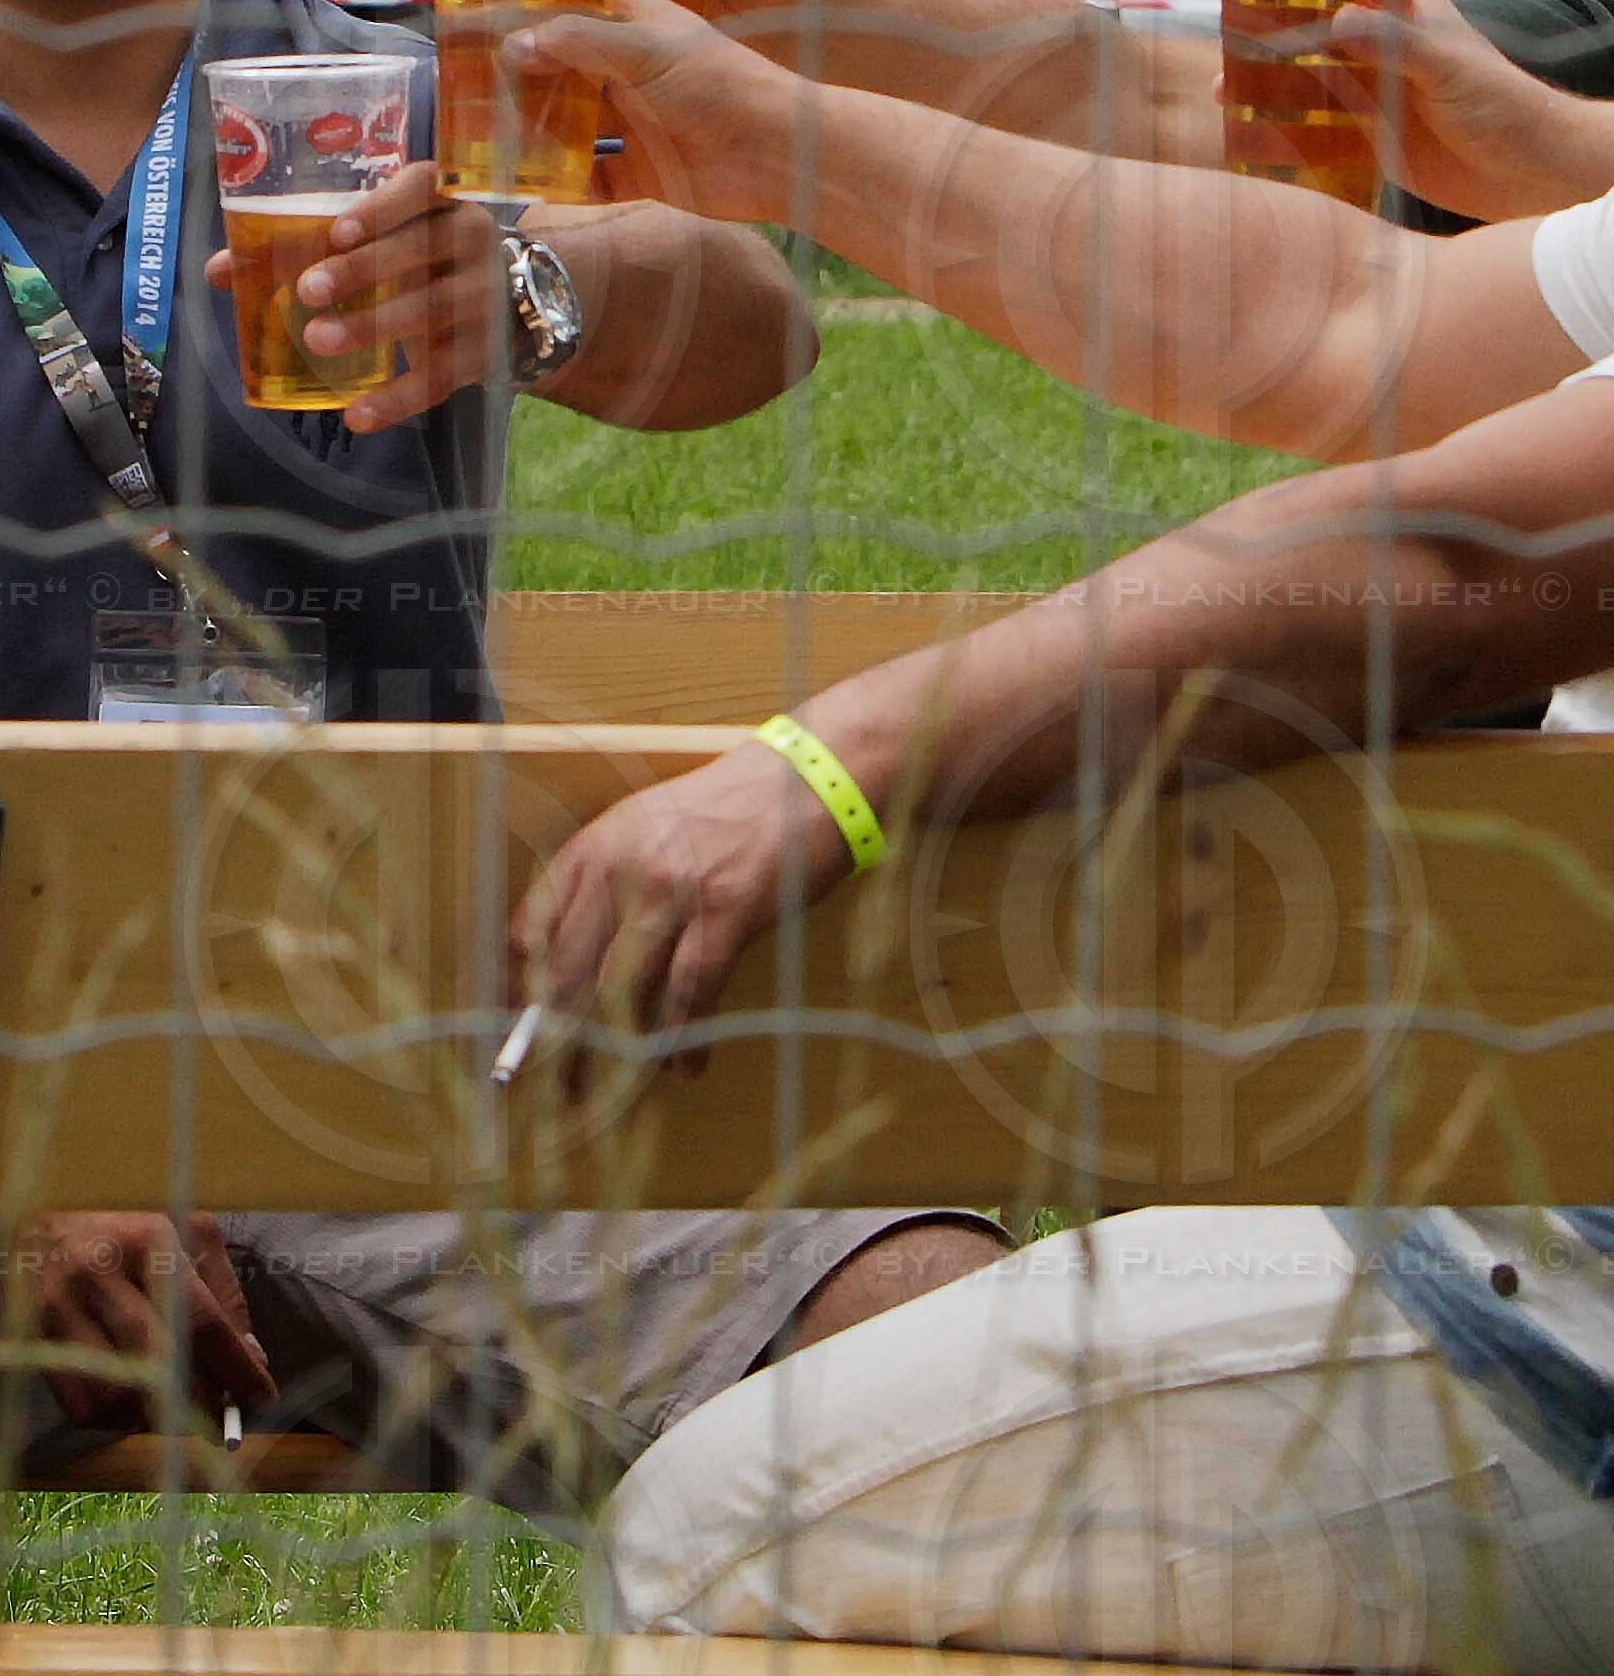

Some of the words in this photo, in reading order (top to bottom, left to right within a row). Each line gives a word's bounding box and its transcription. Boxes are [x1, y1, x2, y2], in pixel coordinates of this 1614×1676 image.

[150, 110, 177, 152] VON
[138, 157, 177, 270] ÖSTERREICH
[134, 275, 162, 326] 2014
